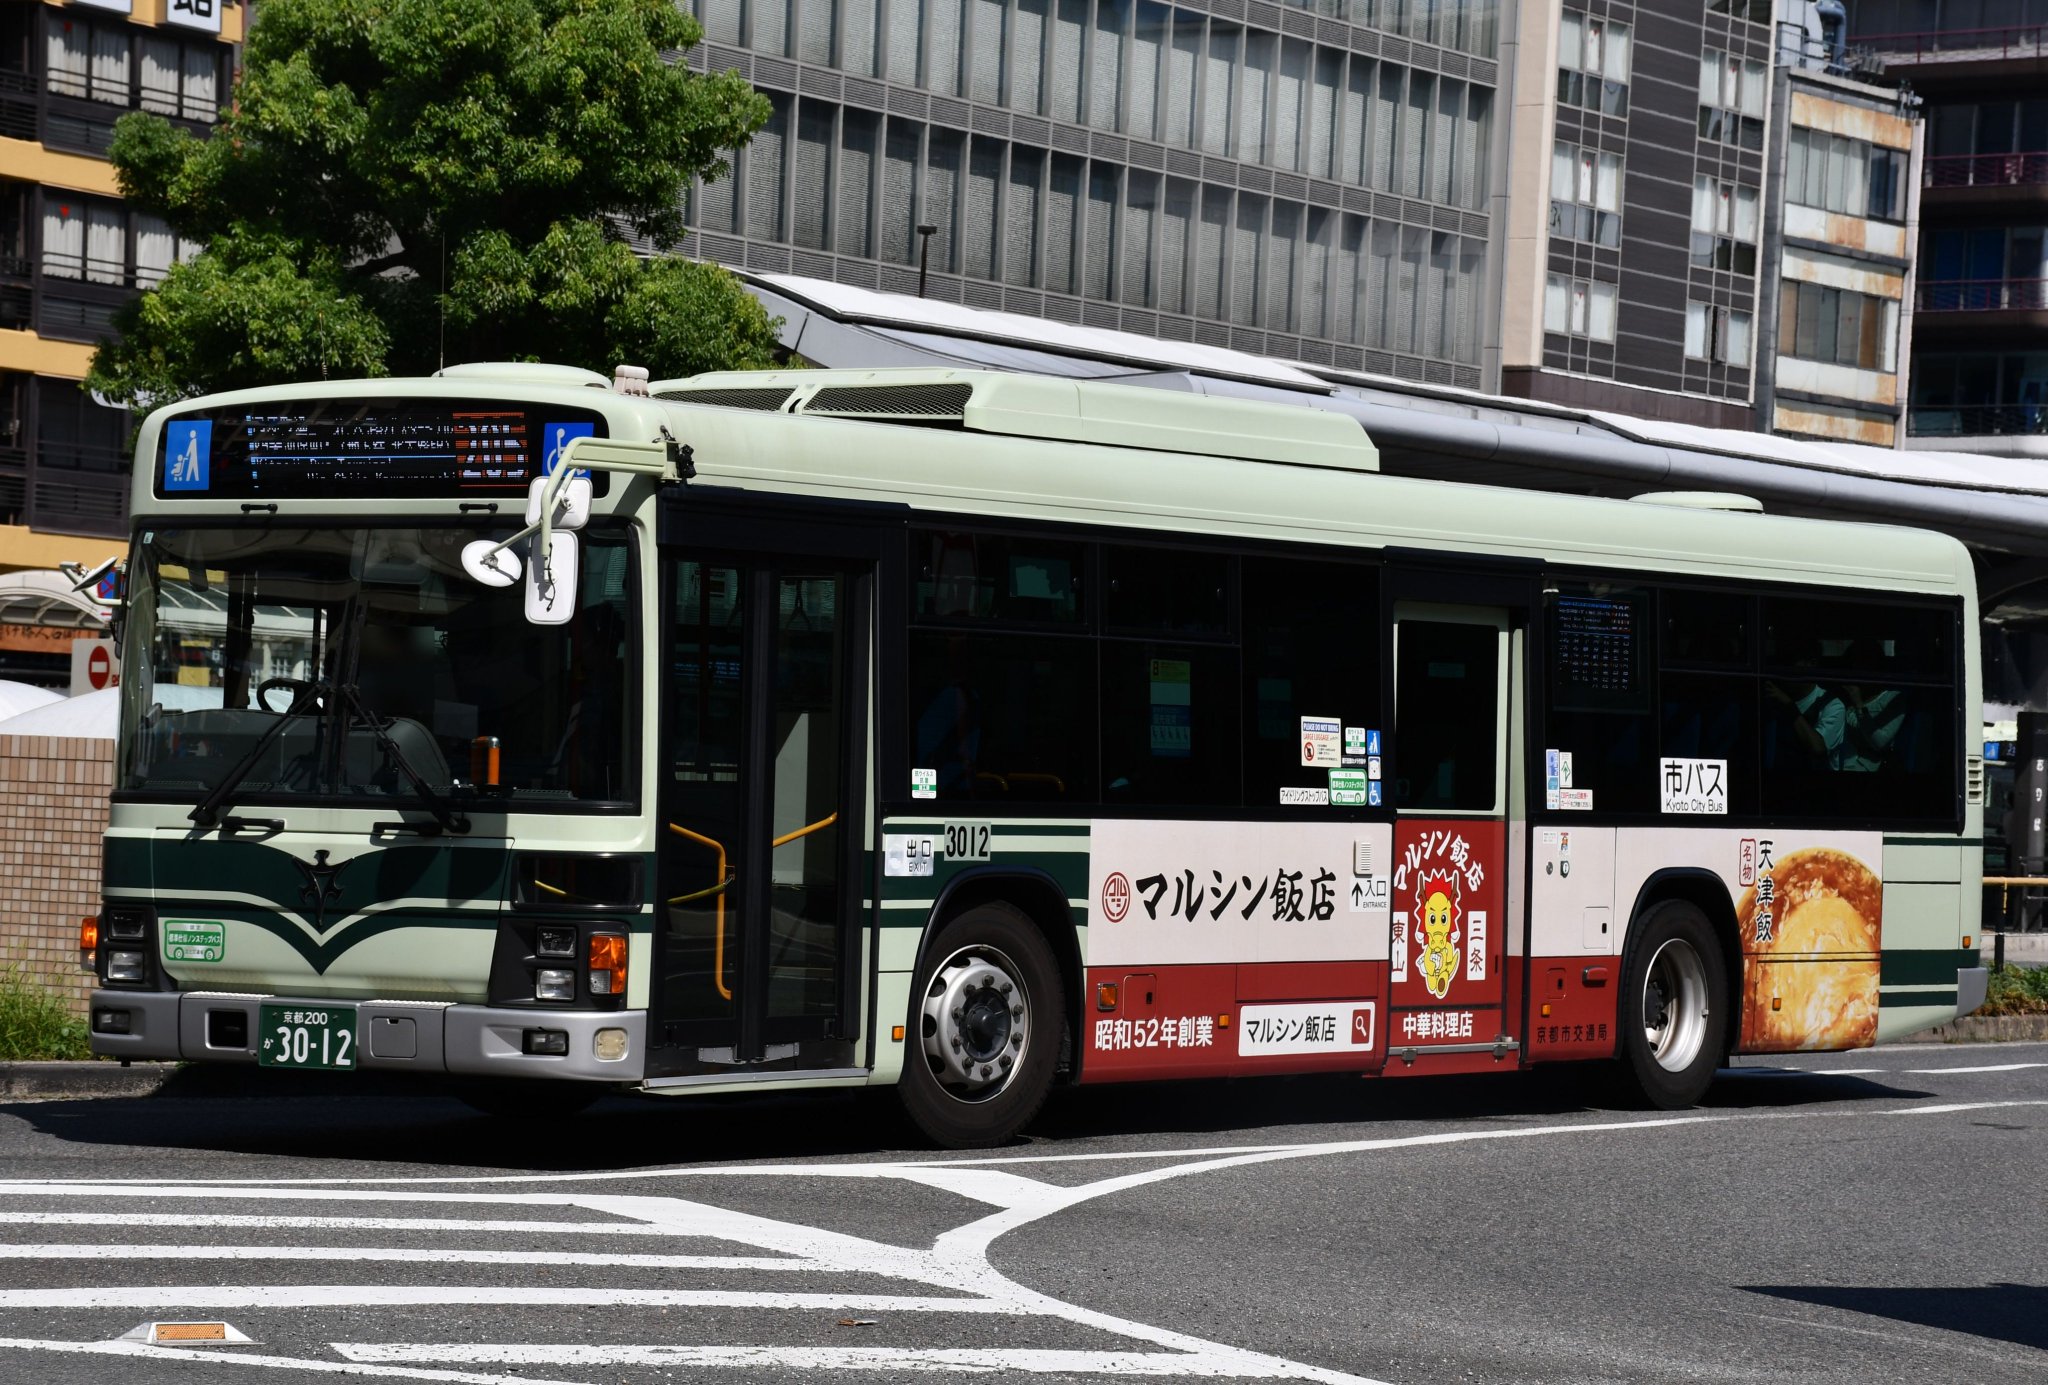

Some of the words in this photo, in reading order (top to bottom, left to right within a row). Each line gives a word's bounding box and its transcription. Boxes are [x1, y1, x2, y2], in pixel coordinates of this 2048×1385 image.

[1665, 760, 1724, 798] 市バス
[1281, 789, 1328, 804] アイドリングストップバス
[1666, 798, 1689, 812] Kyoto
[1691, 799, 1707, 813] City
[1708, 799, 1724, 812] Bus
[906, 839, 932, 858] 出口
[946, 825, 989, 858] 3012
[908, 861, 928, 873] EXIT
[1394, 830, 1486, 893] マルシン飯店
[1742, 845, 1753, 881] 名物
[1135, 867, 1337, 923] マルシン飯店
[1364, 880, 1387, 897] 入口
[1755, 839, 1775, 943] 天津飯
[1362, 901, 1388, 909] ENTRANCE
[1391, 919, 1406, 974] 東山
[1469, 919, 1485, 973] 三条
[283, 1011, 329, 1025] 京都200
[1094, 1016, 1214, 1051] 昭和52年創業
[1245, 1014, 1337, 1044] マルシン飯店
[1402, 1011, 1474, 1040] 中華料理店
[1536, 1023, 1608, 1044] 京都市交通局
[263, 1037, 275, 1050] か
[275, 1026, 352, 1066] 30-12
